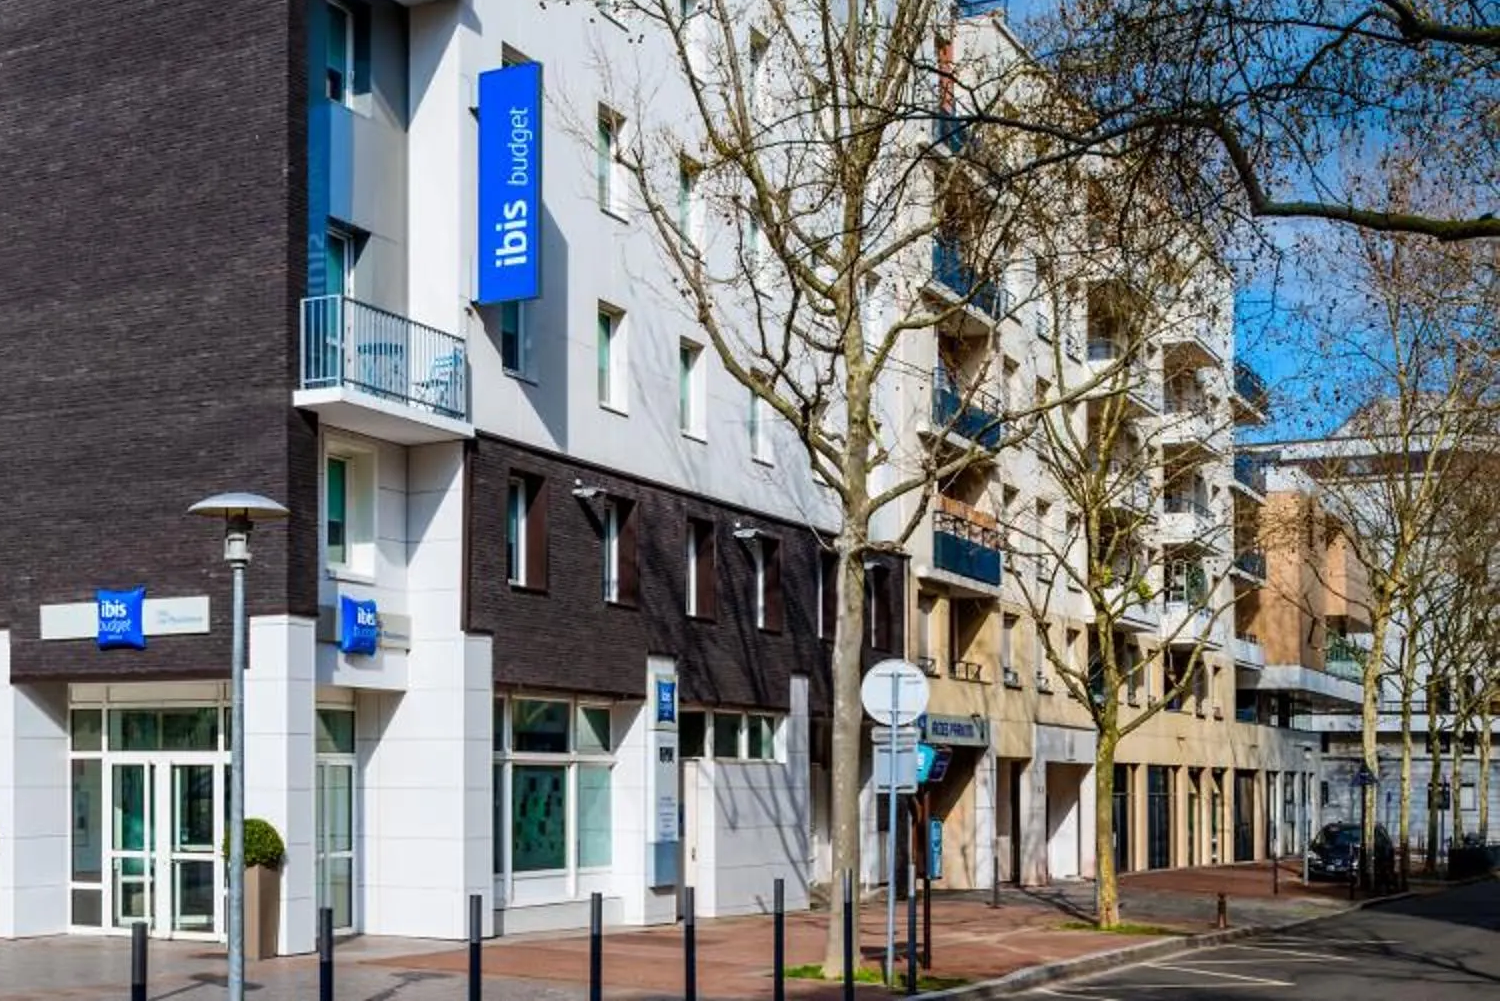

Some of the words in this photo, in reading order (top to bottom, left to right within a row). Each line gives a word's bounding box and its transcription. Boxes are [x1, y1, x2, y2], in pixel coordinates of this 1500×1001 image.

[506, 106, 533, 186] budget
[495, 199, 527, 268] ibis
[101, 600, 127, 618] ibis
